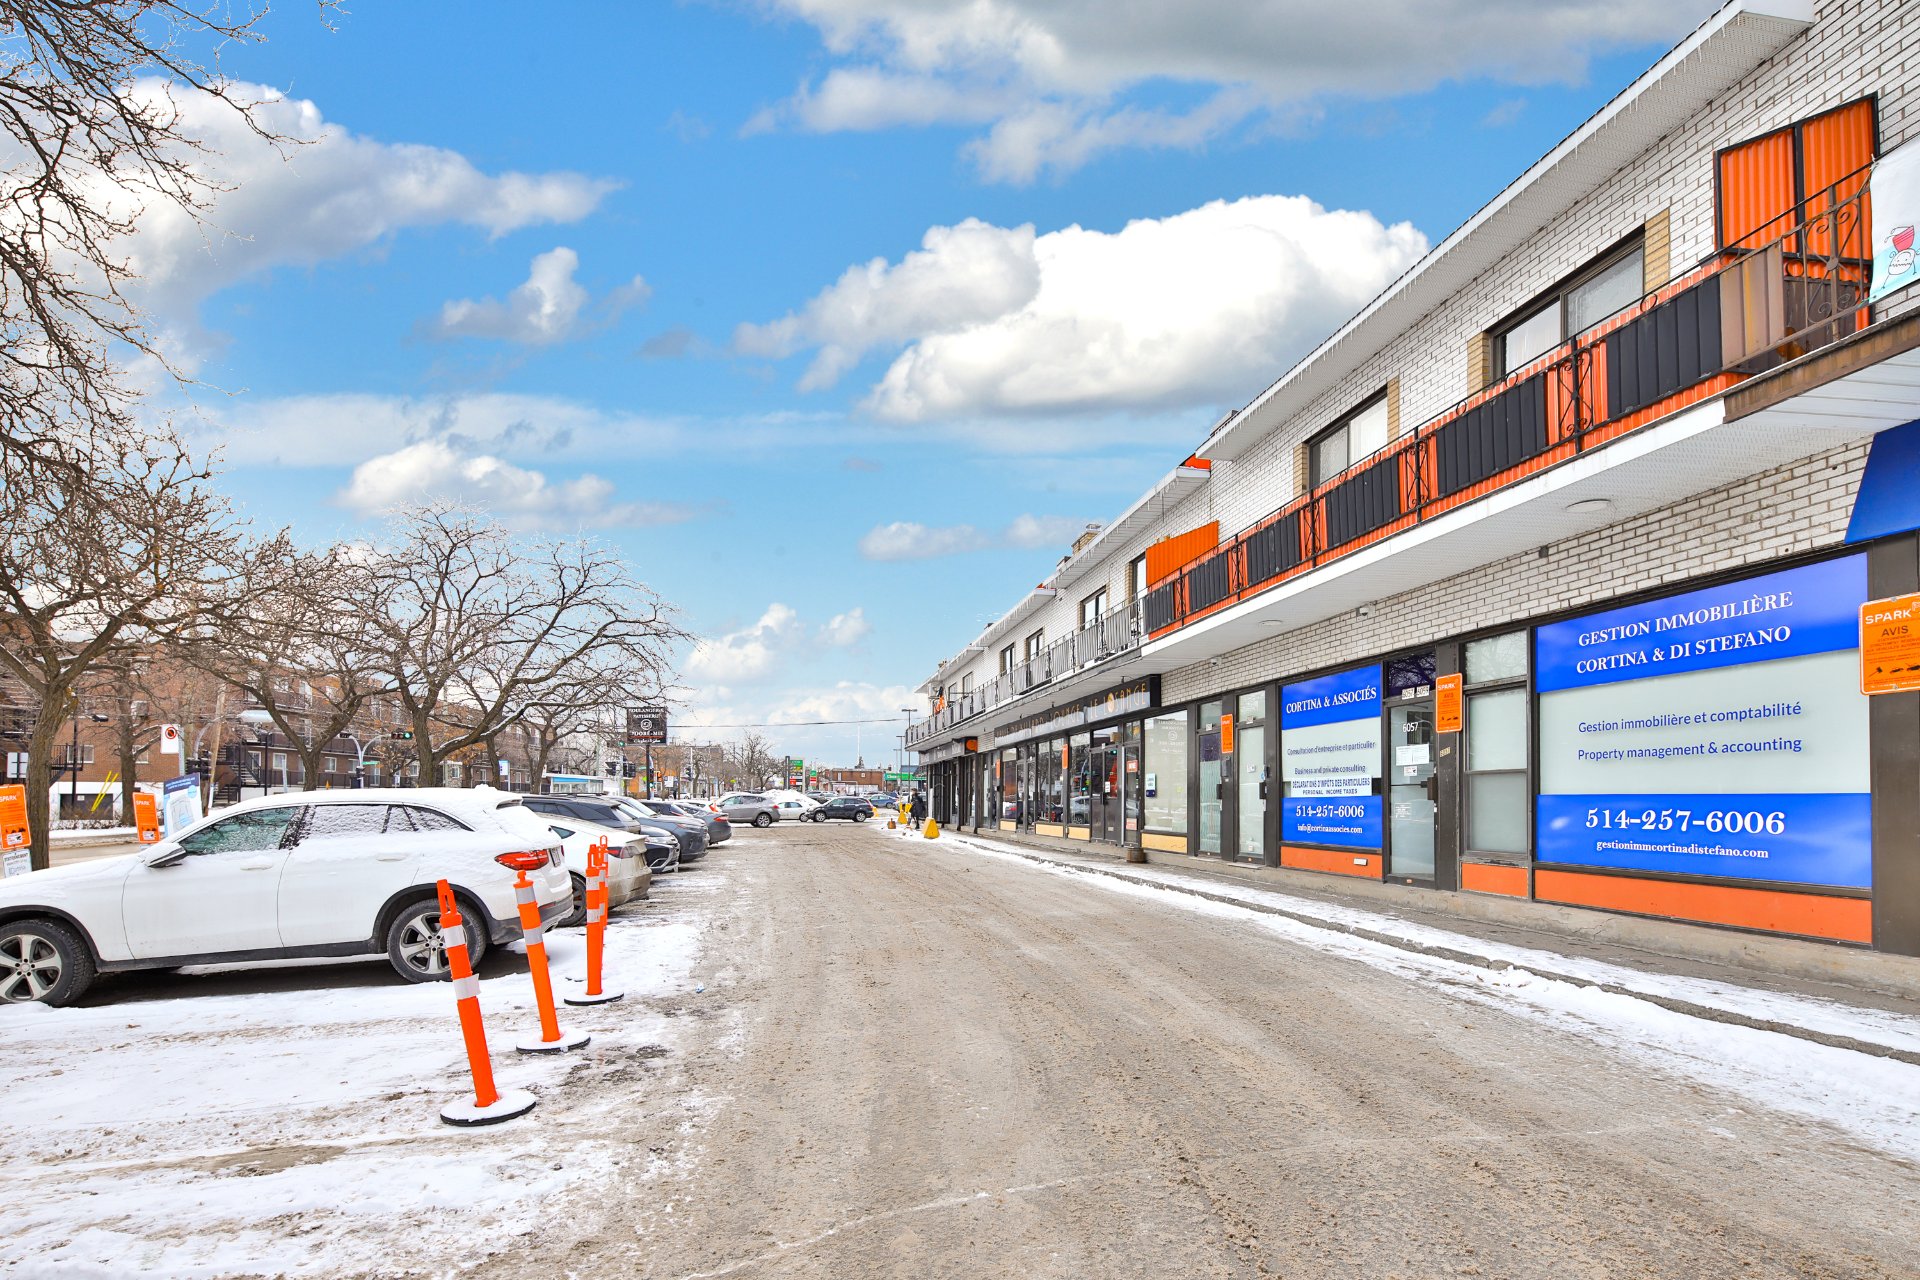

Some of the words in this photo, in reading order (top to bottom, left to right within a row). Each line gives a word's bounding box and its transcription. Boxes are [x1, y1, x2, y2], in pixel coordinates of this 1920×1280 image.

[1578, 620, 1651, 647] GESTION
[1655, 591, 1793, 632] IMMOBILIÈRE
[1865, 609, 1912, 625] SPARK
[1881, 625, 1909, 637] AVIS
[1576, 651, 1648, 674] CORTINA
[1652, 648, 1665, 662] &
[1669, 642, 1690, 660] DI
[1695, 625, 1791, 655] STEFANO
[1438, 682, 1455, 691] SPARK
[1090, 698, 1099, 719] LE
[1286, 697, 1322, 714] CORTINA
[1324, 696, 1330, 707] &
[1332, 685, 1377, 706] ASSOCIÉS
[1402, 721, 1419, 733] 6057
[1578, 722, 1619, 733] Gestion
[1621, 713, 1691, 730] immobilière
[1694, 712, 1707, 723] et
[1710, 701, 1802, 722] comptabilité
[1578, 749, 1624, 762] Property
[1627, 742, 1705, 760] management
[1708, 741, 1719, 754] &
[1721, 737, 1802, 754] accounting
[1340, 763, 1366, 774] consulting
[1295, 804, 1364, 817] 514-257-6006
[1585, 807, 1785, 835] 514-257-6006
[1596, 840, 1769, 859] gestionimmcortinadistefano.com
